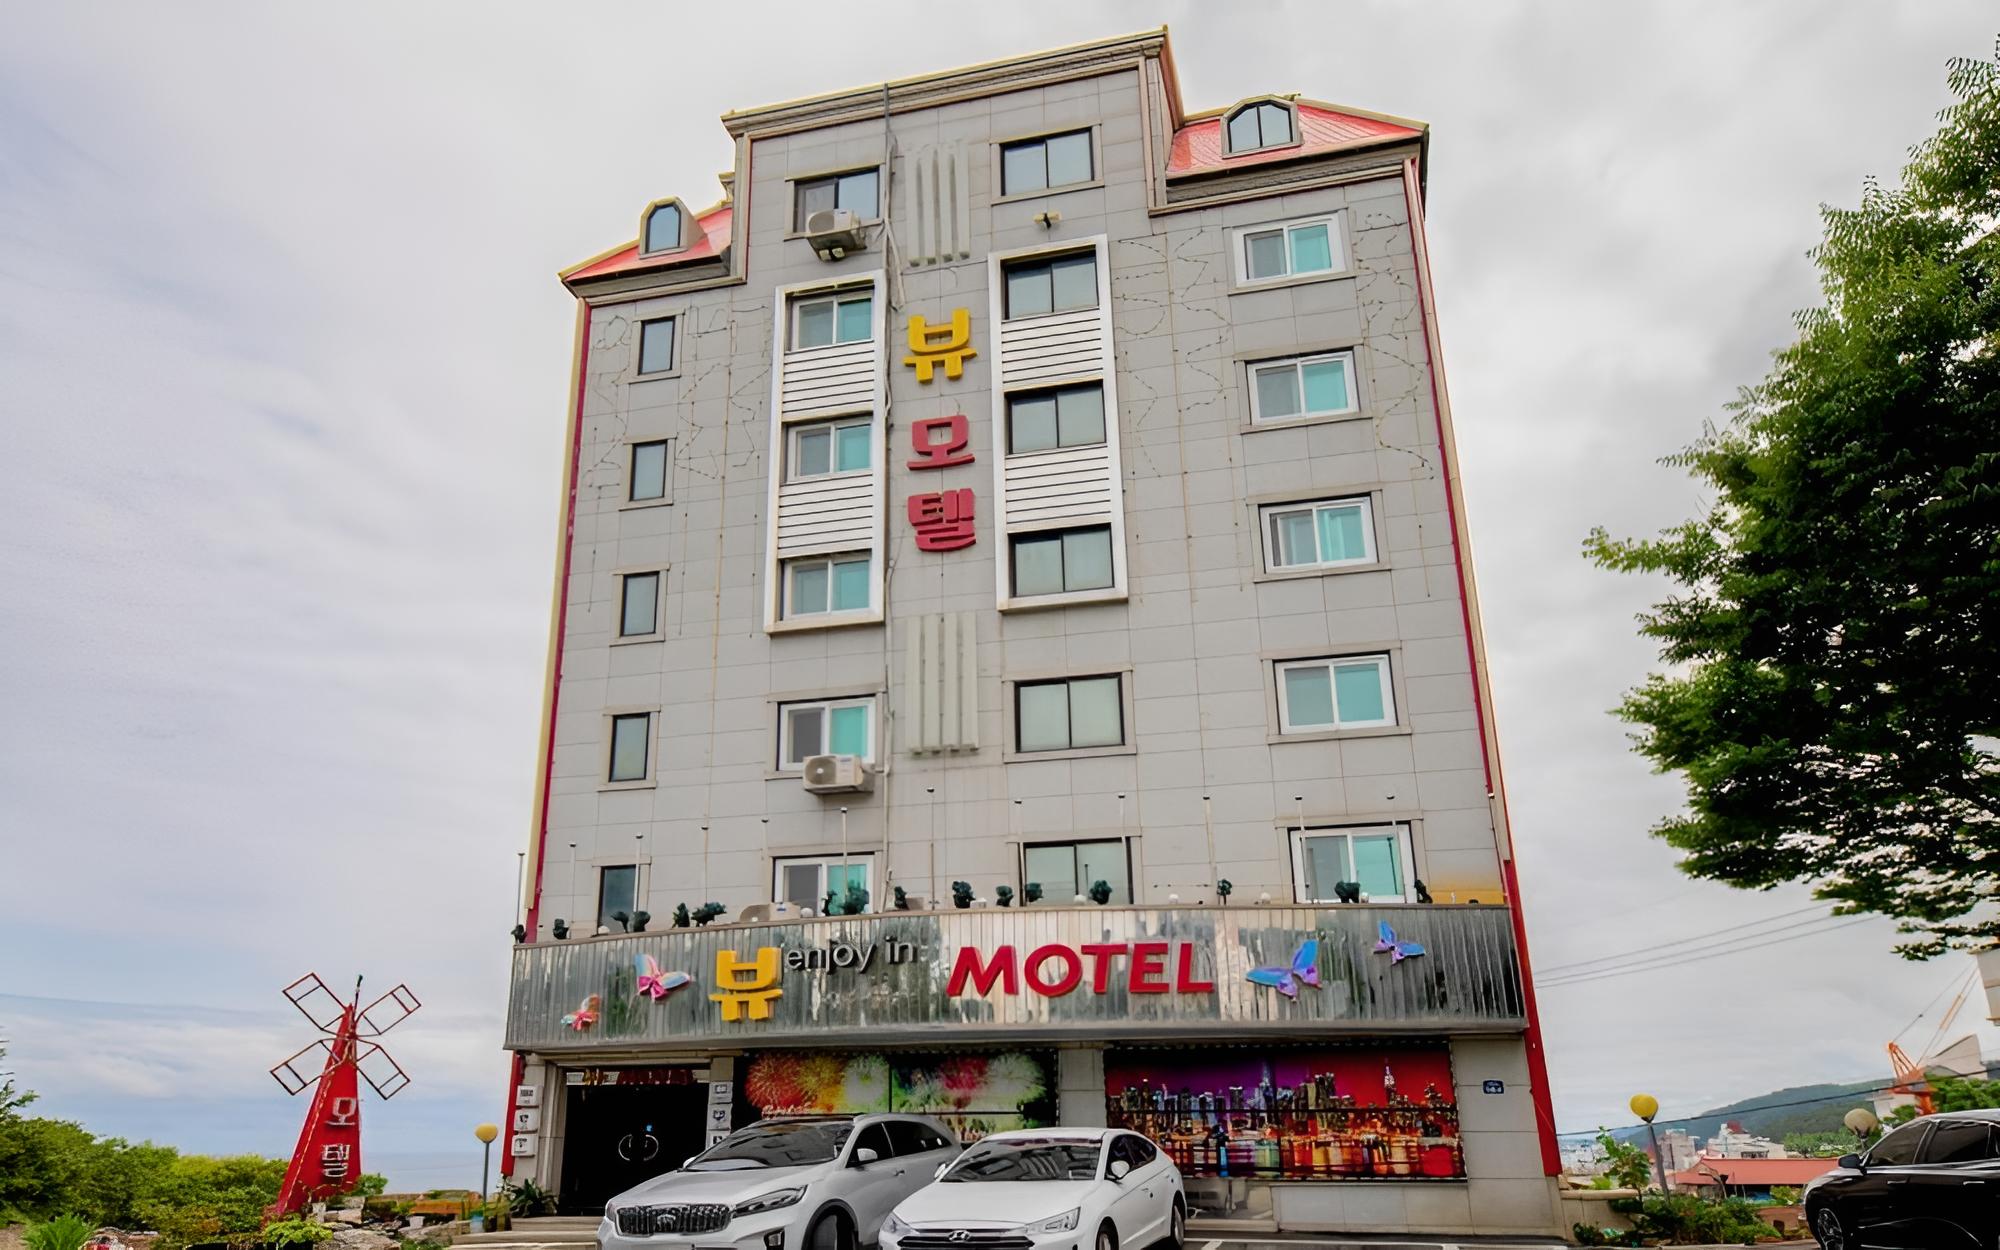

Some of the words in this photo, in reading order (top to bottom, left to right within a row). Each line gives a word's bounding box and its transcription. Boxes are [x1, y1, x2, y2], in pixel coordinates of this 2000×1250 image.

[903, 307, 977, 384] 뷰
[906, 415, 976, 552] 모텔
[708, 946, 783, 1022] 뷰
[786, 939, 877, 974] enjoy
[885, 934, 918, 965] in
[946, 942, 1215, 998] MOTEL
[322, 1097, 357, 1178] 모텔
